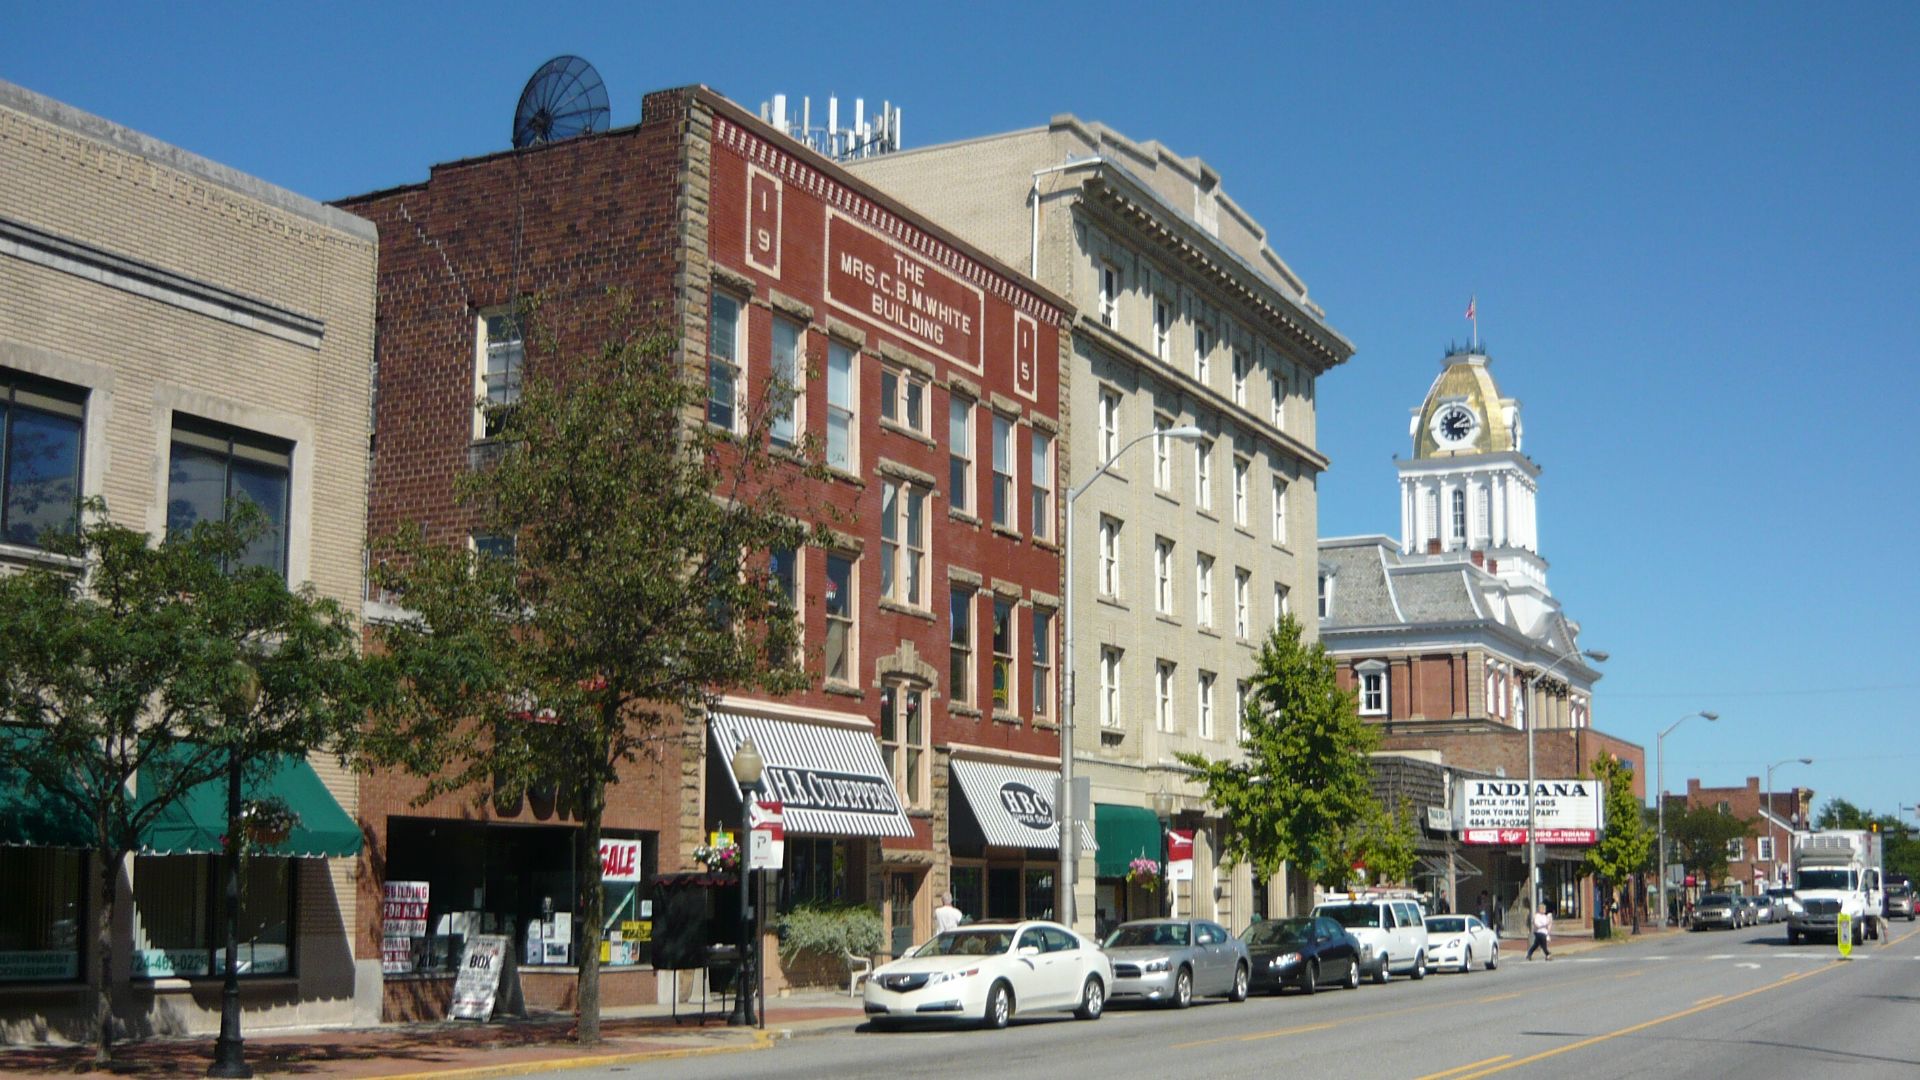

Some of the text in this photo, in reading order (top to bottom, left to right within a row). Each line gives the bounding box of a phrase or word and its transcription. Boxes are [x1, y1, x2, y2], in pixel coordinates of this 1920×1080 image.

[893, 253, 925, 288] THE
[872, 293, 943, 345] BUILDING
[1476, 783, 1589, 797] INDIANA
[1001, 789, 1049, 816] HBC
[1469, 798, 1496, 806] BATTLE
[469, 954, 492, 970] BOX
